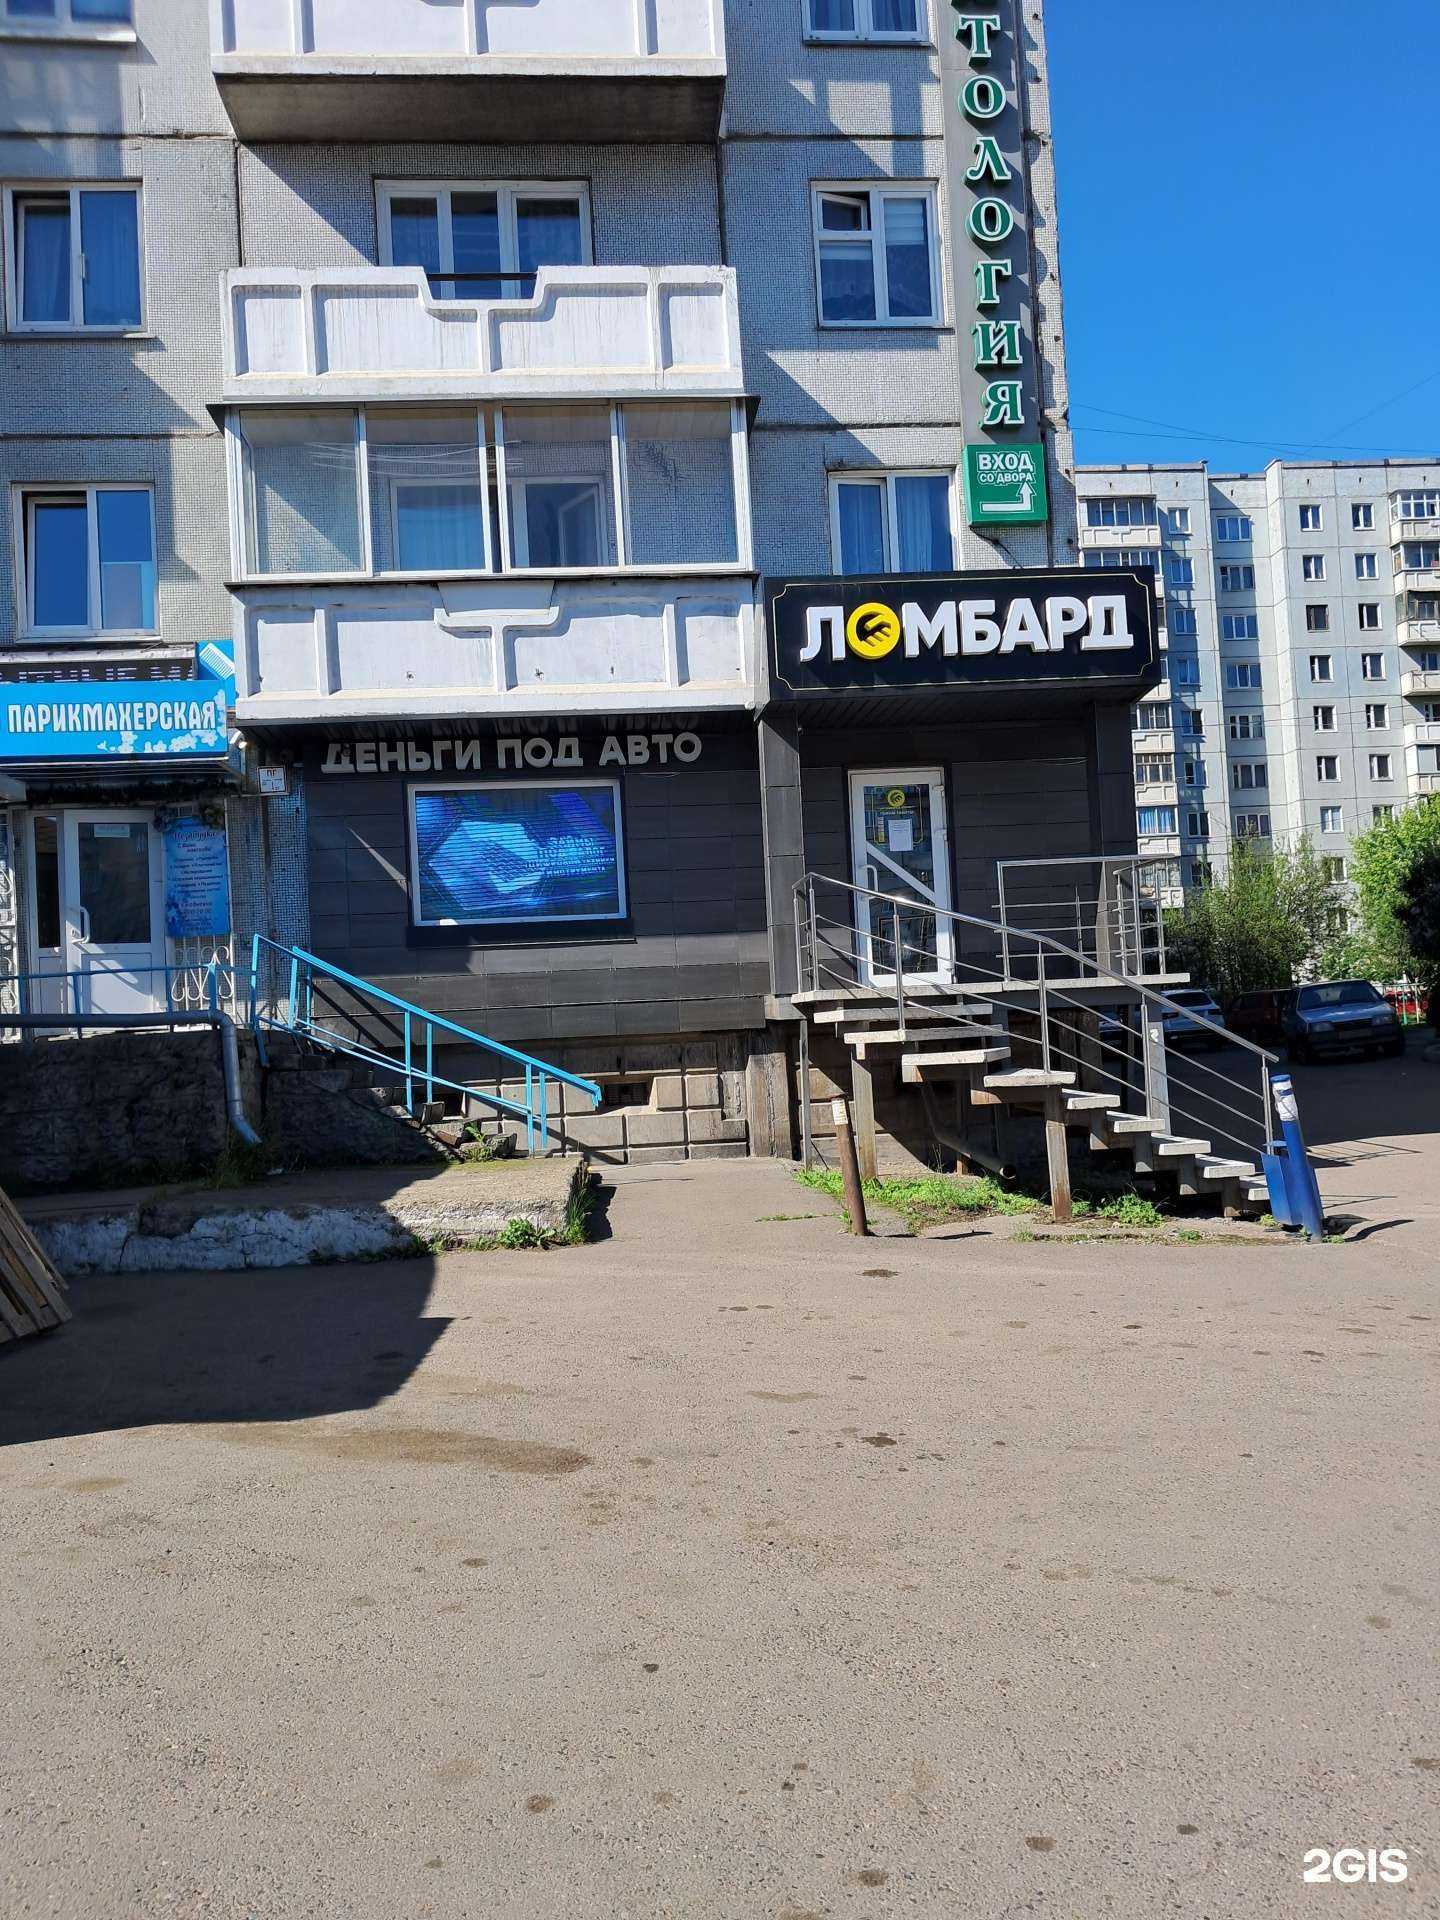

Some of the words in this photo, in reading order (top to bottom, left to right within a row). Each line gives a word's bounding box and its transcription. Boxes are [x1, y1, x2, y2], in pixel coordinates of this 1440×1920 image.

[957, 0, 1025, 425] ТОЛОГИЯ
[977, 452, 1034, 473] ВХОД
[979, 473, 995, 483] СО
[996, 472, 1034, 484] ДВОРА
[800, 594, 1135, 662] ЛОМБАРД
[7, 701, 216, 733] ПАРИКМАХЕРСКАЯ
[320, 739, 481, 774] ДЕНЬГИ
[496, 737, 584, 769] ПОД
[598, 731, 702, 766] АВТО
